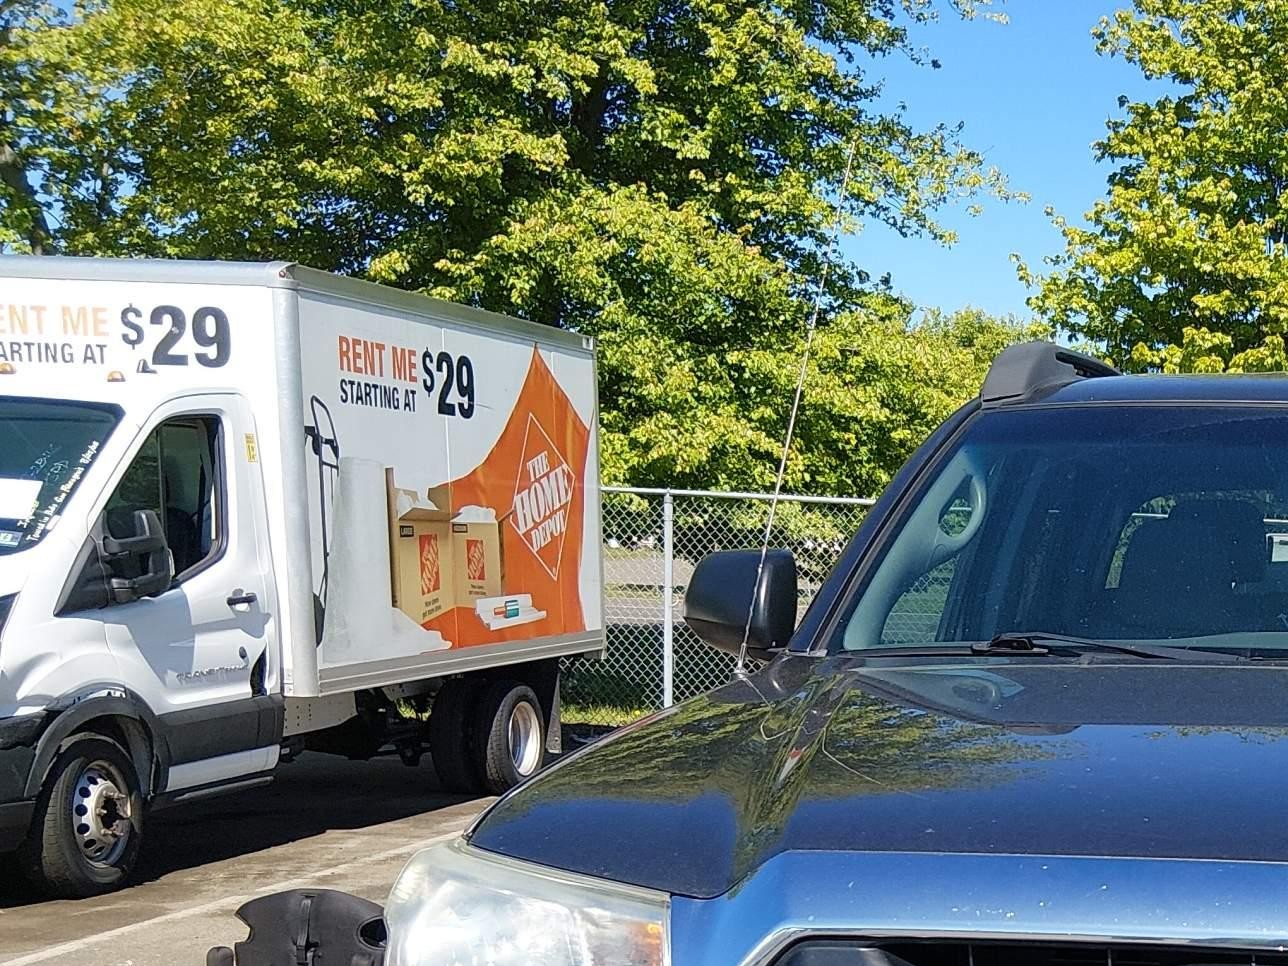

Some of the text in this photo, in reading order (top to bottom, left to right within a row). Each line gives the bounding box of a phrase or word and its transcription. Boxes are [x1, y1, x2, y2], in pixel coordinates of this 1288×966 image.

[62, 305, 109, 336] ME
[121, 303, 232, 369] $29
[83, 343, 108, 365] AT
[338, 335, 418, 383] RENT ME
[339, 378, 417, 412] STARTING AT
[421, 346, 475, 419] $29
[526, 450, 550, 482] THE
[514, 463, 571, 535] HOME
[530, 509, 566, 552] DEPOT
